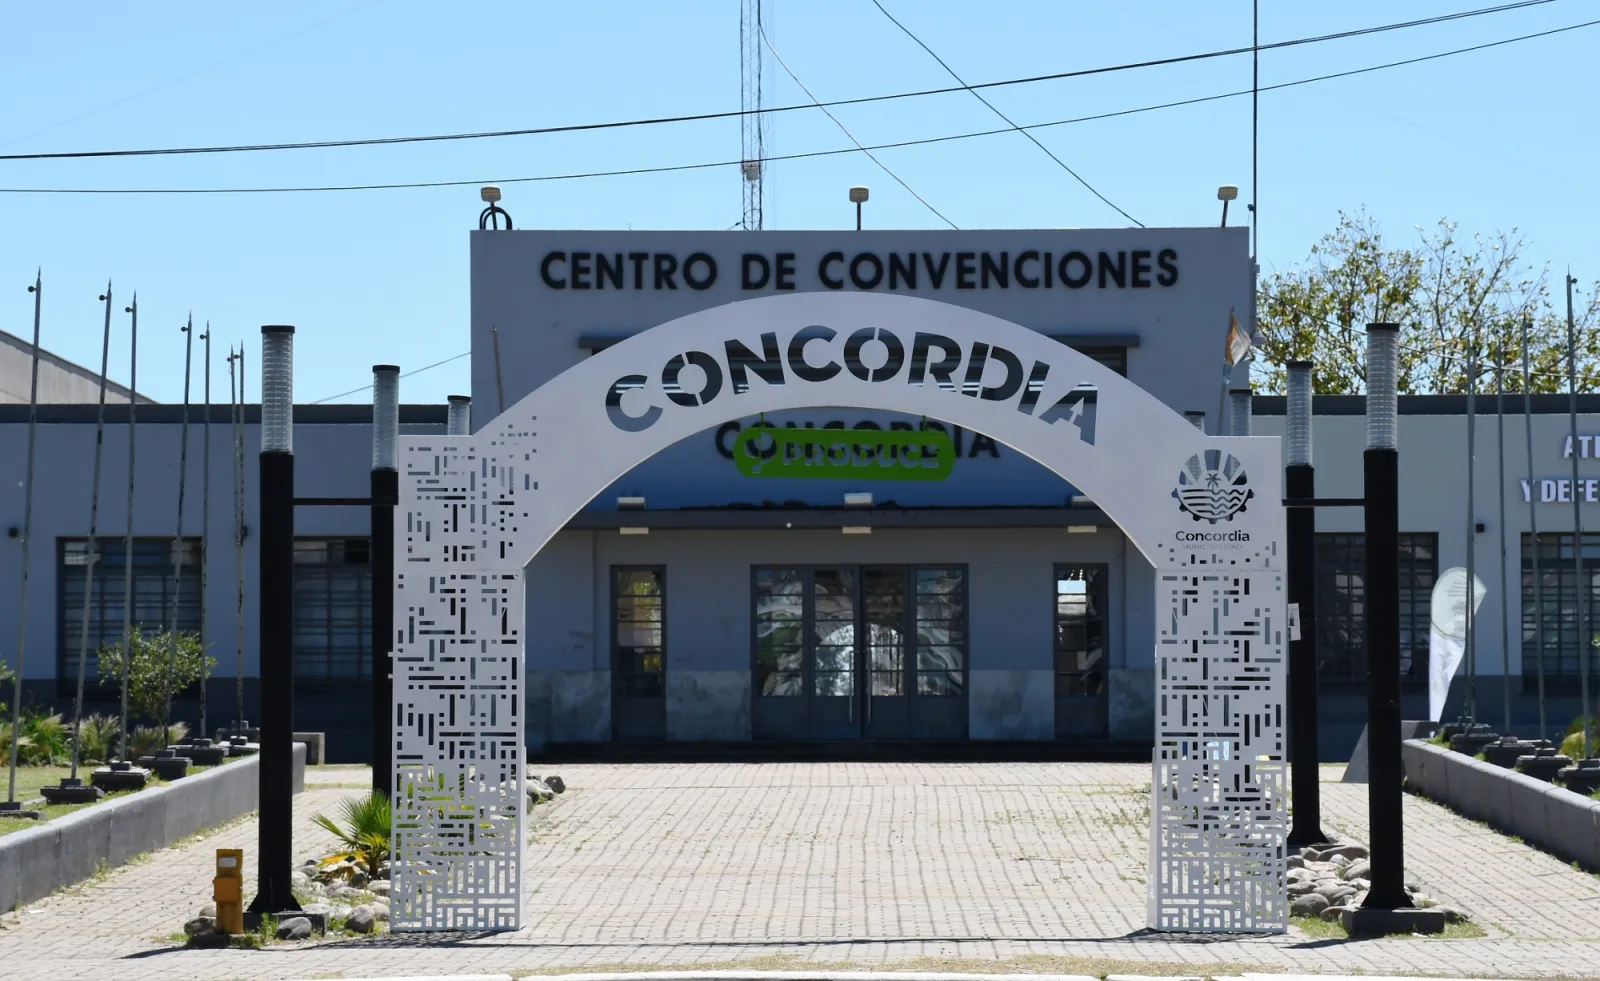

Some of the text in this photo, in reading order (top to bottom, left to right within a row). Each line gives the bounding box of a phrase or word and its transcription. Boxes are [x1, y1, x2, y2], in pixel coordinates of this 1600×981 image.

[541, 249, 1180, 291] CENTRO DE CONVENCIONES
[605, 325, 1099, 446] CONCORDIA
[782, 442, 939, 468] PRODUCE
[1175, 530, 1250, 541] Concordia
